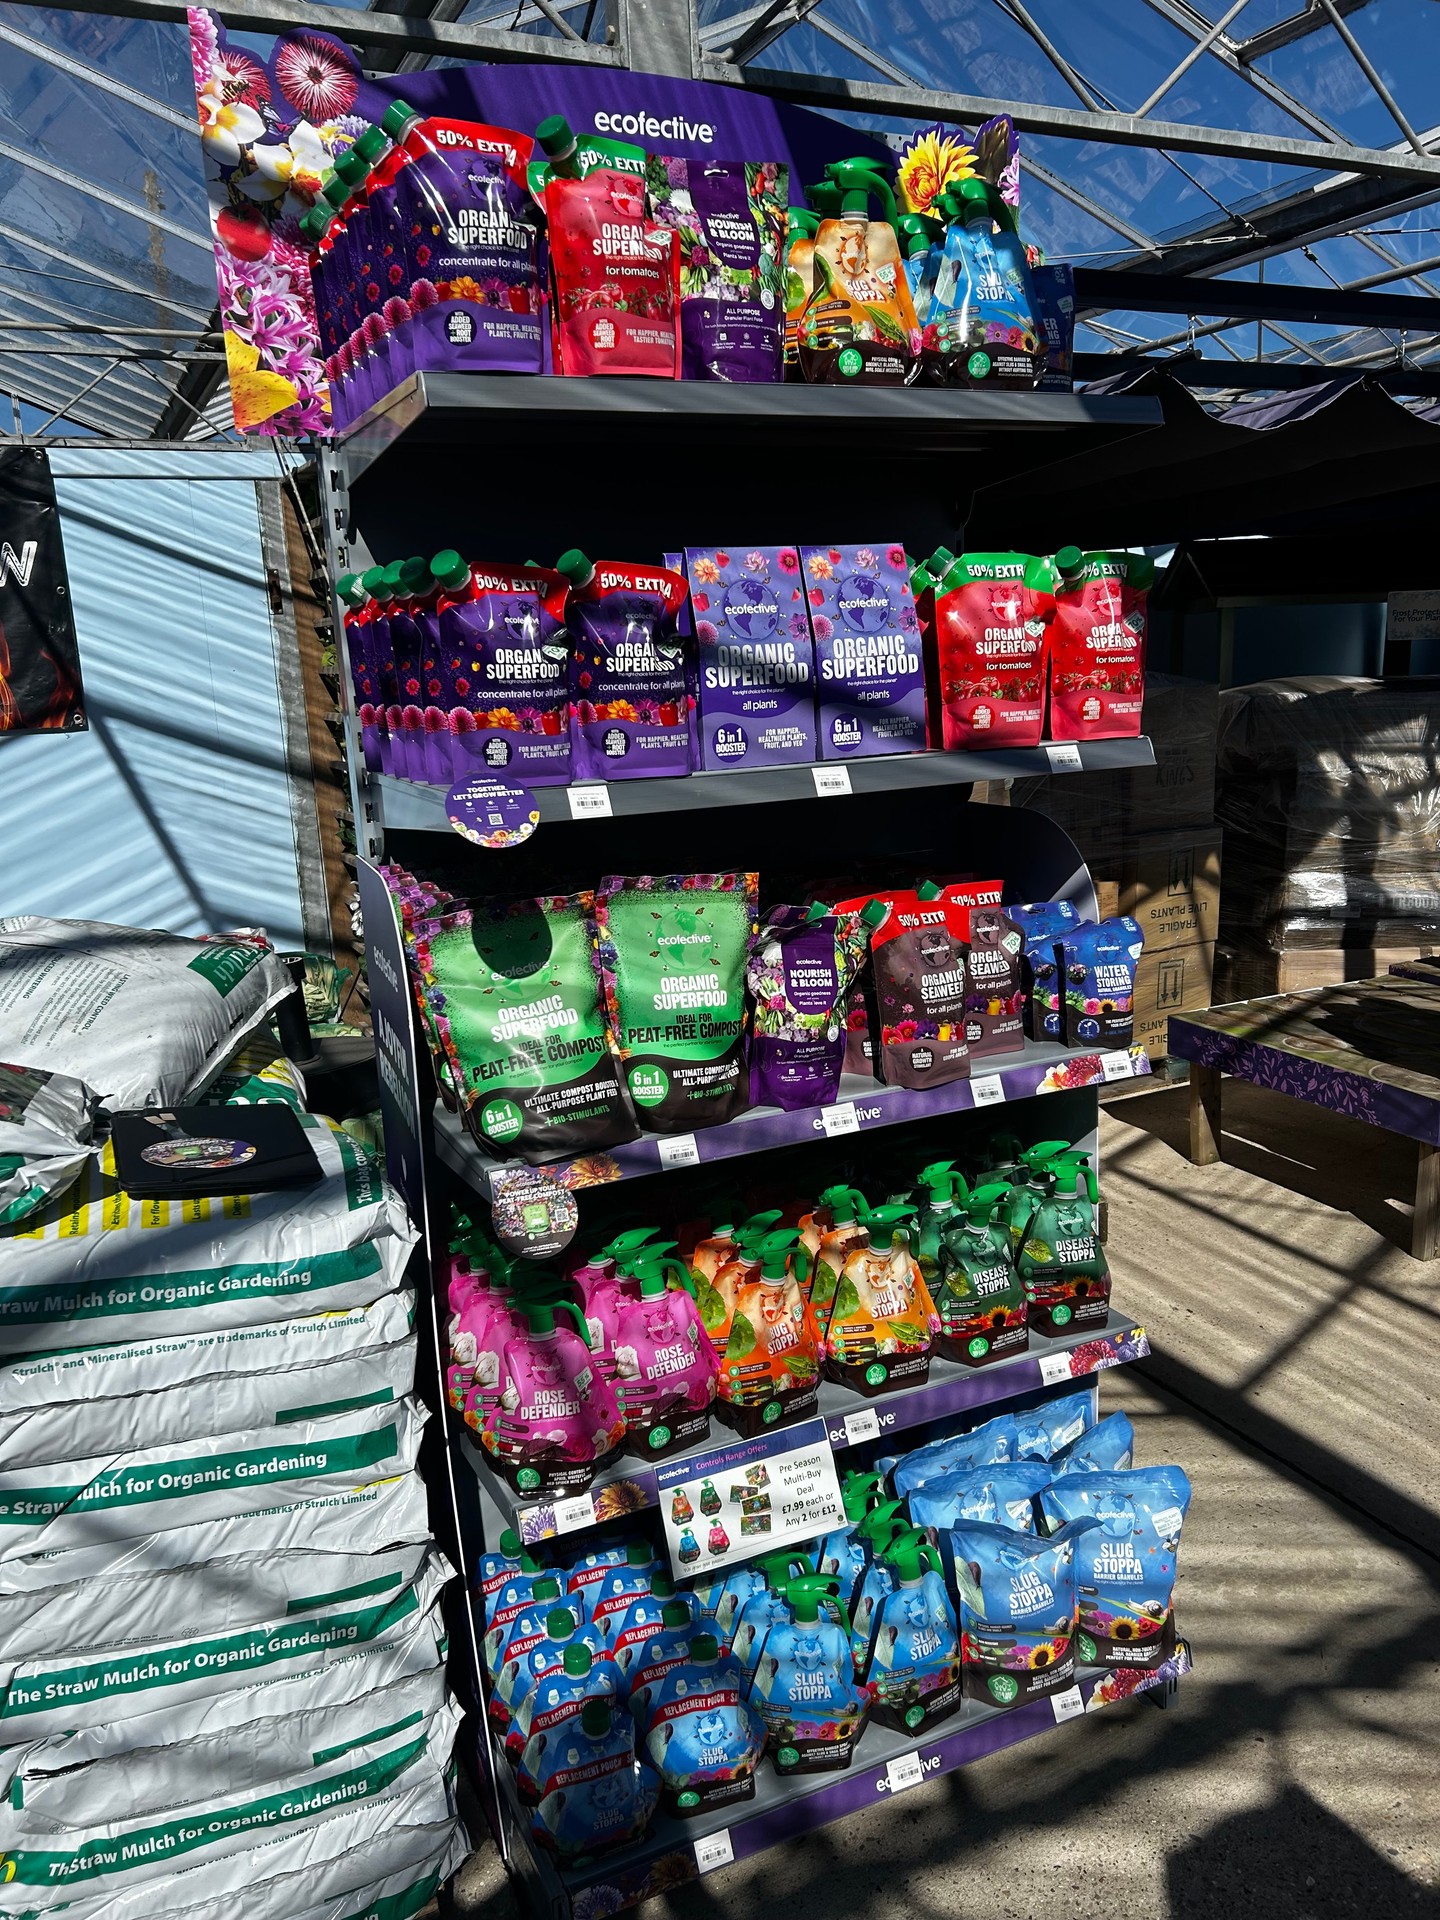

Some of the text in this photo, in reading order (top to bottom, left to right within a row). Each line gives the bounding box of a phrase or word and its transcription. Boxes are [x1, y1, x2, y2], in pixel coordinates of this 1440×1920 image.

[594, 111, 713, 143] ecofective
[436, 130, 474, 153] 50%
[447, 228, 528, 251] SUPERFOOD
[439, 257, 497, 270] concentrate
[606, 265, 660, 280] for tomatoes
[966, 564, 994, 578] 50%
[474, 573, 508, 592] 50%
[600, 572, 672, 599] 50% EXTRA
[725, 603, 777, 616] ecofective
[839, 598, 887, 610] ecofective
[717, 642, 795, 669] ORGANIC
[833, 635, 905, 659] ORGANIC
[822, 654, 919, 681] SUPERFOOD
[986, 661, 1032, 670] for tomatoes
[1096, 656, 1136, 665] for tomatoes
[486, 663, 560, 682] SUPERFOOD
[705, 664, 809, 690] SUPERFOOD
[477, 688, 531, 699] concentrate
[598, 680, 649, 691] concentrate
[857, 689, 890, 702] all plants
[743, 699, 778, 712] all plants
[777, 728, 800, 736] HAPPIER,
[834, 718, 858, 733] 6 in 1
[718, 728, 743, 743] 6 in 1
[758, 733, 808, 743] HEALTHIER PLANTS,
[764, 739, 803, 749] FRUIT, AND VEG
[833, 732, 862, 743] BOOSTER
[715, 742, 746, 754] BOOSTER
[452, 789, 525, 801] LET'S GROW BETTER
[1150, 901, 1208, 918] LIVE PLANTS
[1159, 918, 1198, 933] FRAGILE
[657, 933, 711, 946] ecofective
[790, 968, 832, 979] NOURISH
[1094, 965, 1129, 978] WATER
[660, 973, 719, 993] ORGANIC
[799, 977, 833, 988] BLOOM
[975, 980, 995, 990] for all
[1096, 976, 1131, 988] STORING
[498, 994, 563, 1023] ORGANIC
[653, 989, 728, 1011] SUPERFOOD
[926, 1004, 946, 1014] for all
[490, 1007, 579, 1043] SUPERFOOD
[675, 1012, 713, 1025] IDEAL FOR
[544, 1033, 562, 1046] FOR
[628, 1020, 741, 1044] PEAT-FREE COMPOST
[547, 1035, 608, 1064] COMPOST
[633, 1071, 660, 1085] 6 in 1
[524, 1083, 593, 1108] ULTIMATE COMPOST
[632, 1084, 664, 1096] BOOSTER
[536, 1090, 606, 1114] ALL-PURPOSE PLANT
[486, 1111, 494, 1124] 6
[487, 1117, 519, 1136] BOOSTER
[539, 1184, 556, 1193] YOUR
[1055, 1236, 1095, 1251] DISEASE
[1059, 1247, 1095, 1264] STOPPA
[972, 1264, 1009, 1285] DISEASE
[107, 1270, 311, 1306] for Organic Gardening
[976, 1277, 1010, 1296] STOPPA
[62, 1313, 366, 1369] and Mineralised are trademarks of Strulch Limited
[767, 1331, 799, 1355] STOPPA
[654, 1343, 685, 1363] ROSE
[646, 1351, 696, 1381] DEFENDER
[534, 1389, 566, 1405] ROSE
[521, 1401, 580, 1420] DEFENDER
[658, 1443, 768, 1482] ecofective Controls Range Offers
[778, 1455, 821, 1475] Pre Season
[125, 1451, 327, 1494] for Organic Gardening
[783, 1468, 822, 1487] Multi-Buy
[796, 1485, 814, 1497] Deal
[13, 1499, 69, 1516] Straw
[305, 1491, 378, 1510] Strulch Limited
[781, 1492, 834, 1515] £7.99 each or
[785, 1504, 837, 1529] Any 2 for £12
[1096, 1510, 1131, 1520] ecofective
[1100, 1542, 1134, 1559] SLUG
[1093, 1557, 1143, 1574] STOPPA
[1010, 1569, 1041, 1592] SLUG
[1093, 1572, 1144, 1581] BARRIER GRANULES
[1009, 1583, 1054, 1610] STOPPA
[8, 1687, 41, 1707] The
[45, 1676, 99, 1699] Straw
[103, 1665, 160, 1688] Mulch
[163, 1658, 191, 1678] for
[194, 1643, 265, 1674] Organic
[267, 1624, 358, 1656] Gardening
[794, 1671, 825, 1688] SLUG
[789, 1685, 833, 1702] STOPPA
[664, 1698, 706, 1717] REPLACEMENT
[702, 1745, 724, 1757] SLUG
[697, 1753, 728, 1767] STOPPA
[69, 1848, 118, 1875] Straw
[121, 1832, 176, 1861] Mulch
[178, 1826, 205, 1848] for
[208, 1809, 278, 1838] Organic
[280, 1778, 368, 1822] Gardening
